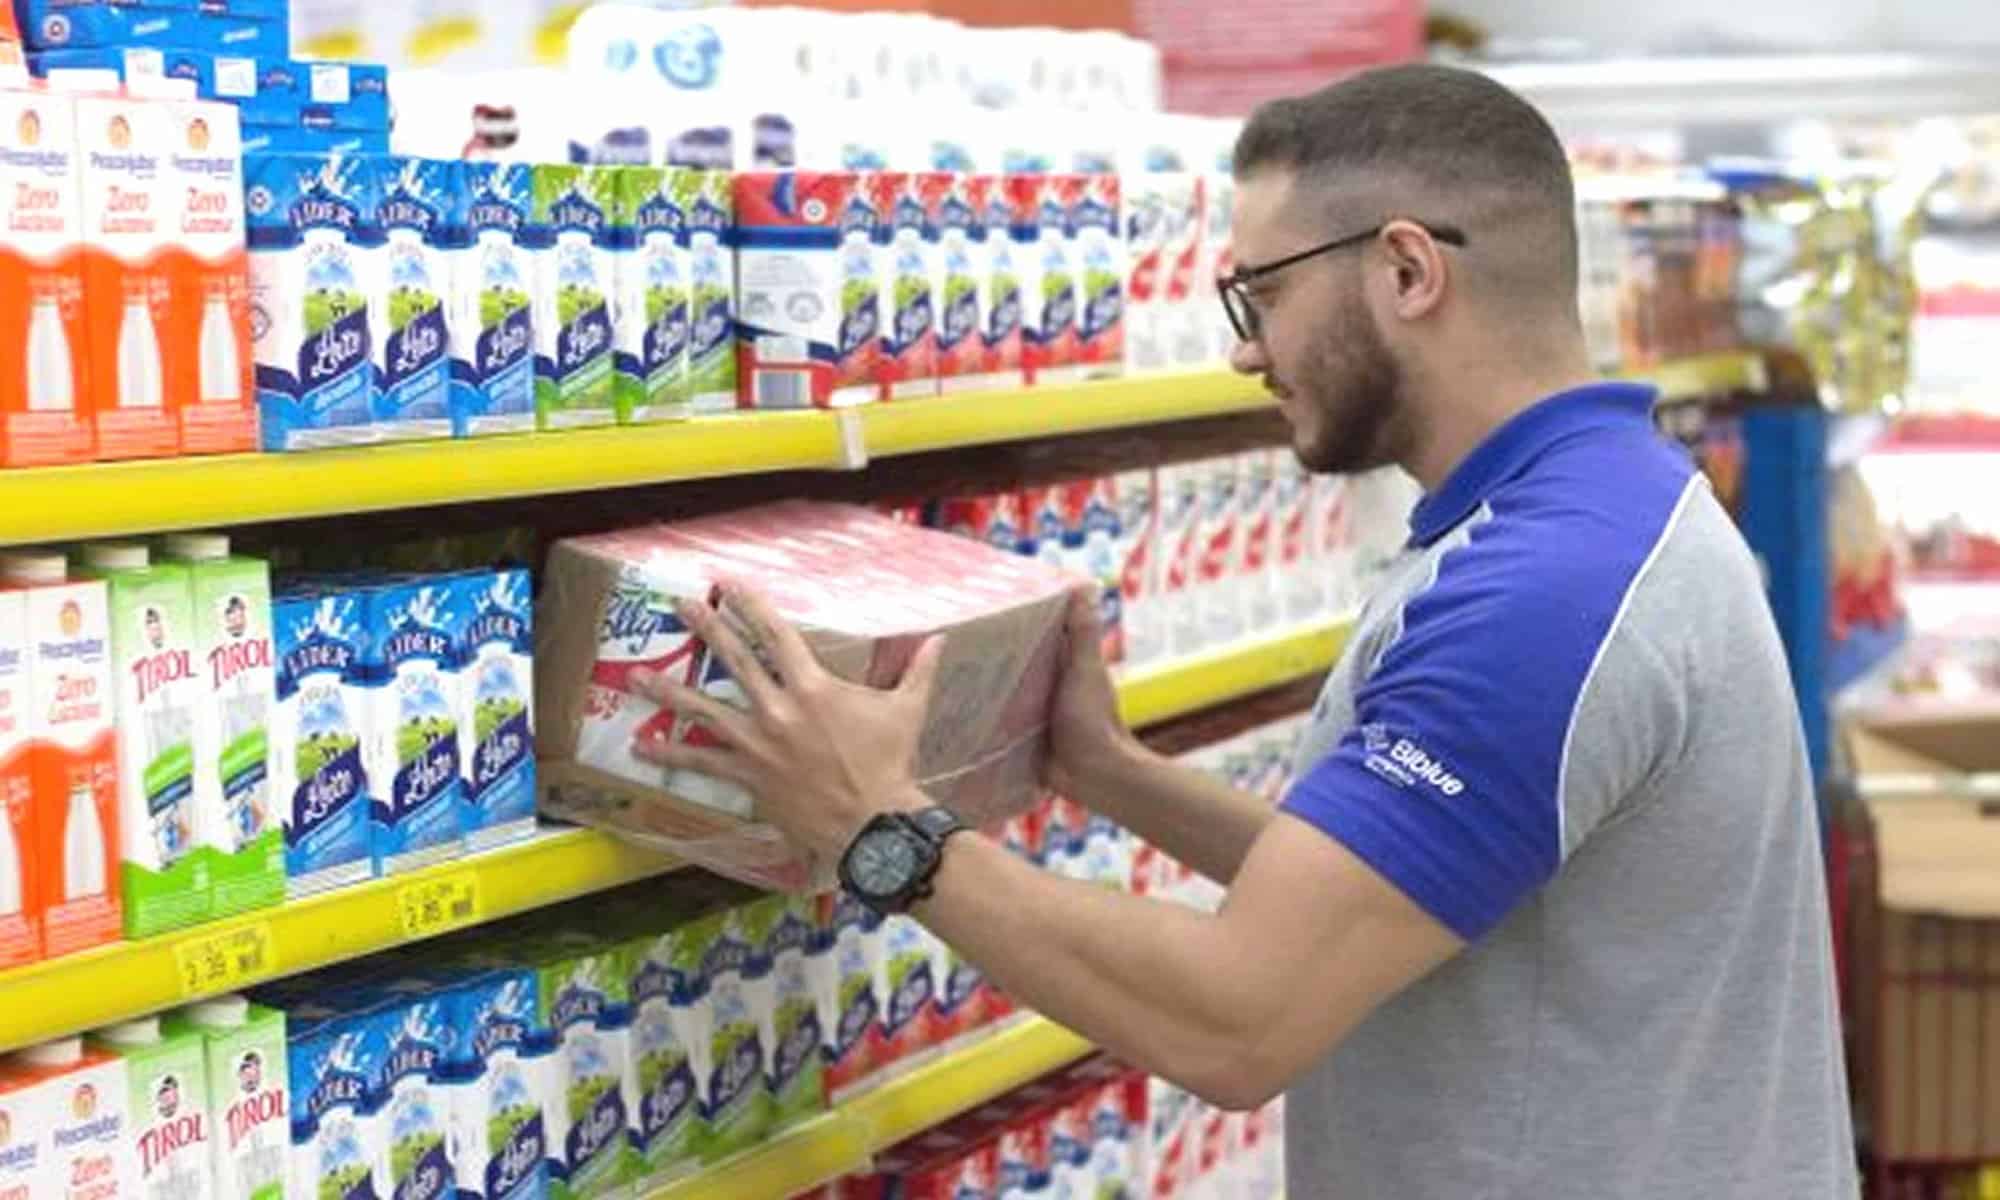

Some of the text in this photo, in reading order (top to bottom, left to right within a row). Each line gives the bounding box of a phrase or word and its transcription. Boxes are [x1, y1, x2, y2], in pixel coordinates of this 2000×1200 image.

[131, 649, 198, 704] TIROL
[207, 638, 274, 691] TIROL
[1390, 738, 1464, 796] Biblue
[138, 1112, 208, 1178] TIROL
[225, 1087, 288, 1151] TIROL
